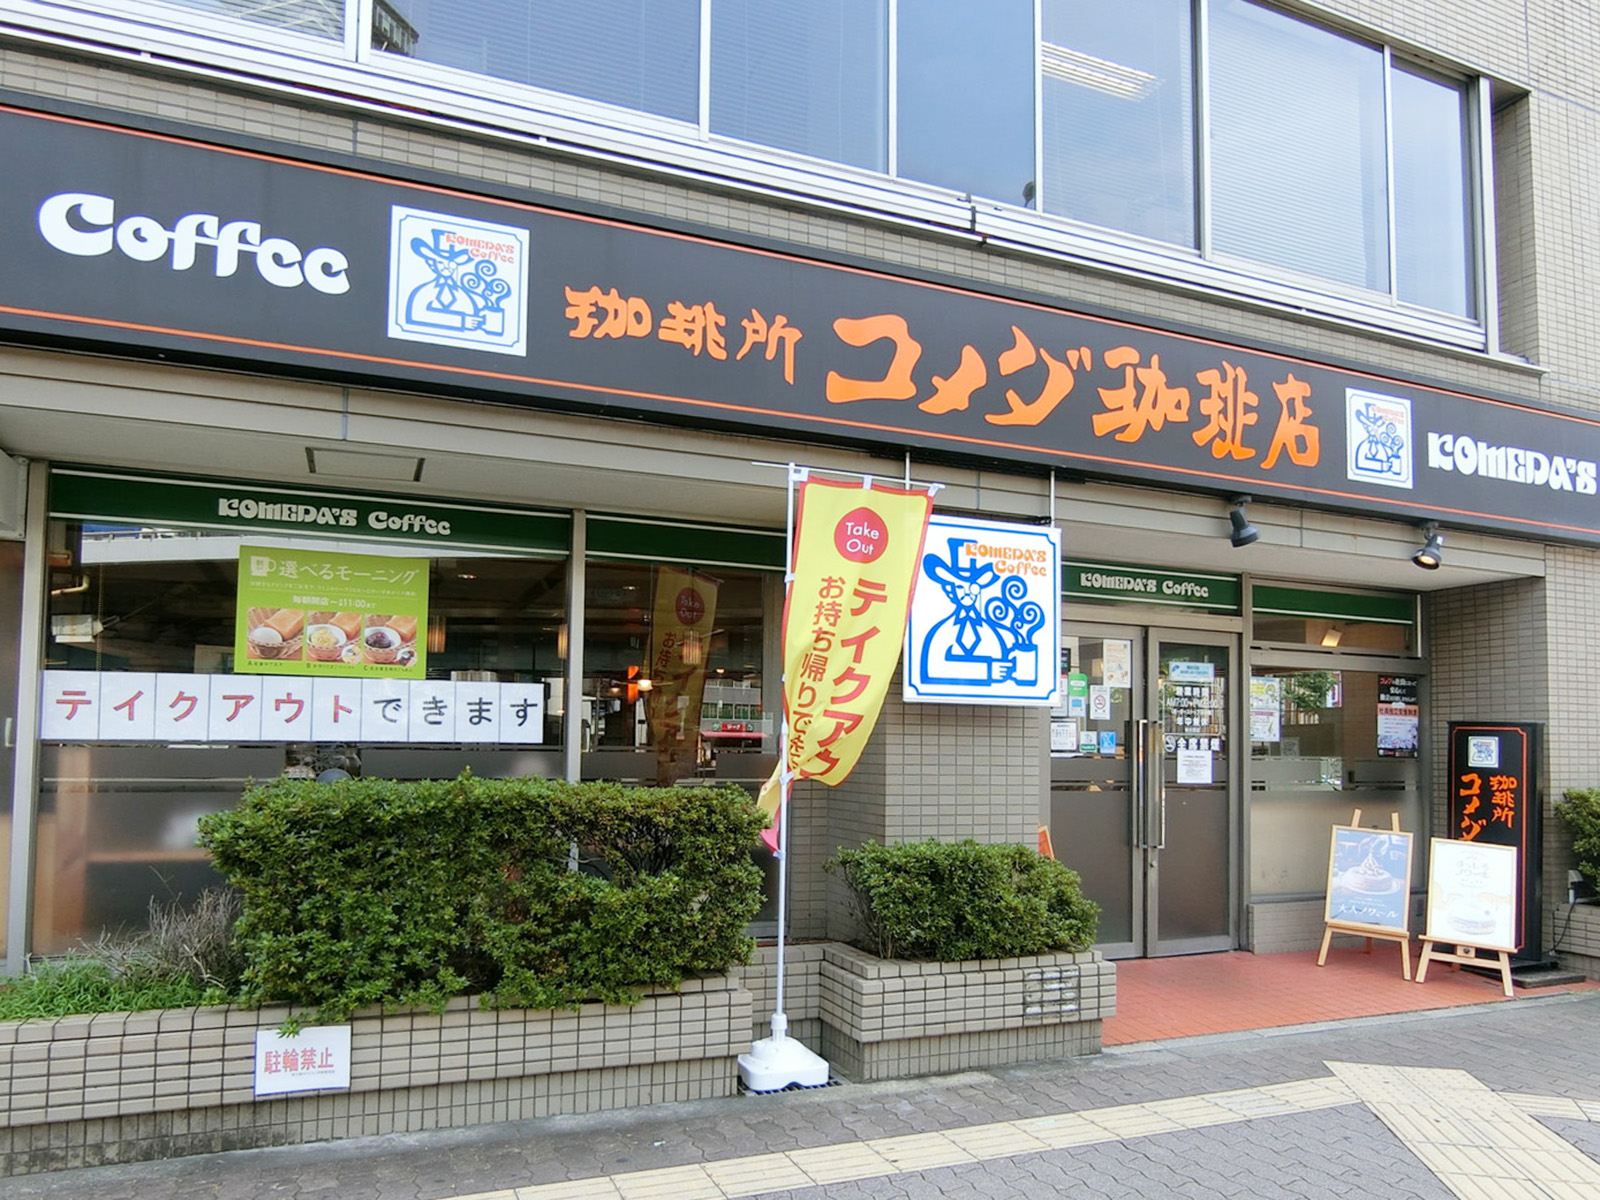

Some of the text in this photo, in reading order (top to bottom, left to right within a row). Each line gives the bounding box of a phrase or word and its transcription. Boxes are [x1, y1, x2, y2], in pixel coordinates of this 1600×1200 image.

[39, 192, 351, 295] Coffee
[445, 233, 515, 255] KOMEDA'S
[469, 248, 515, 264] Coffee
[825, 313, 1320, 470] コメダ珈琲店
[1427, 432, 1598, 495] KOMEDA'S
[218, 498, 451, 536] KOMEDA'S Coffee
[845, 522, 880, 539] Take
[846, 538, 874, 555] Out
[965, 542, 1047, 563] KOMEDA'S
[278, 559, 420, 586] 選べるモーニング
[994, 560, 1047, 577] Coffee
[1080, 572, 1209, 598] KOMEDA'S Coffee
[55, 689, 539, 726] テイクアウトできます
[1459, 773, 1487, 841] コメダ
[263, 1046, 335, 1075] 駐輪禁止
